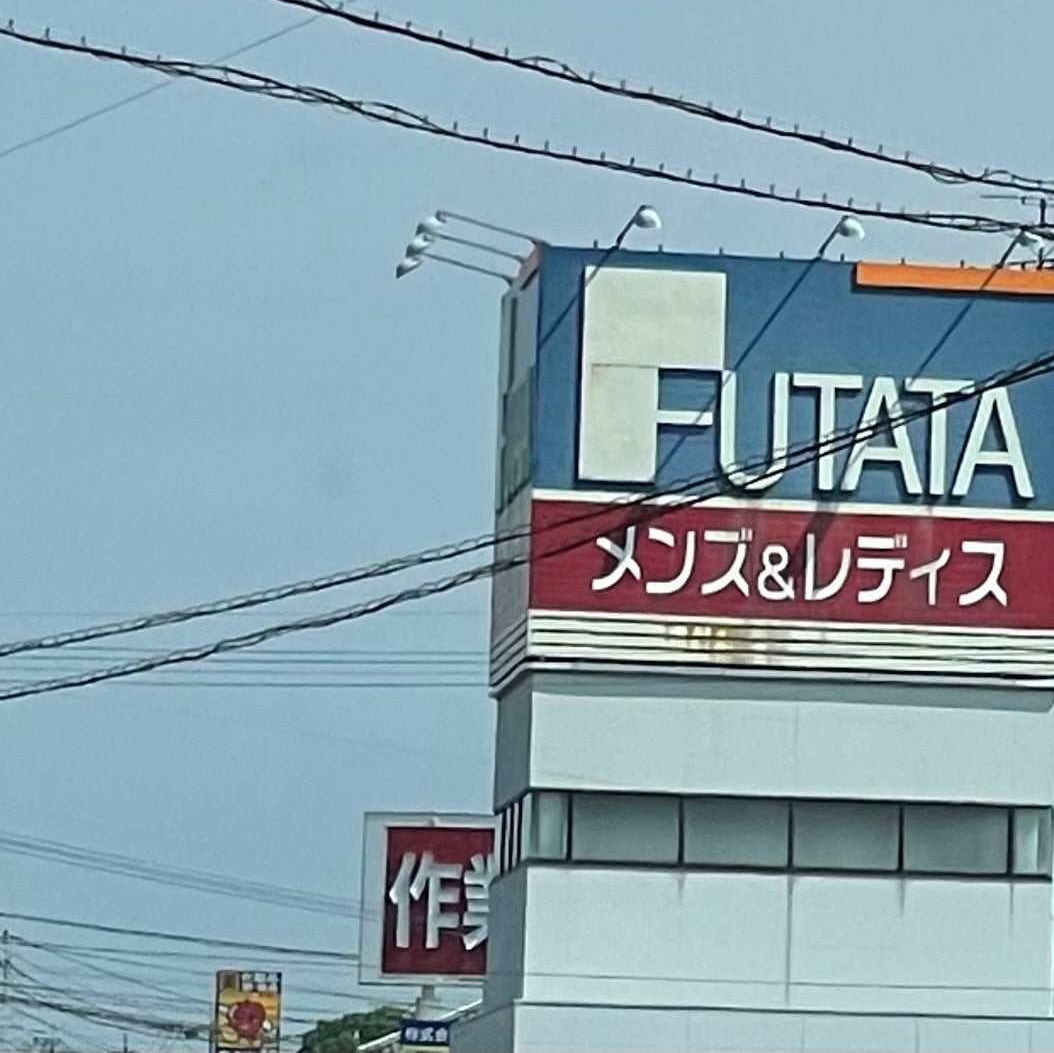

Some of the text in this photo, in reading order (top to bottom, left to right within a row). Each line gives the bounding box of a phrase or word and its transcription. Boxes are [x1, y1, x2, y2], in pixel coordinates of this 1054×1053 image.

[578, 266, 1034, 498] FUTATA
[590, 526, 1008, 606] メンズ&レディス
